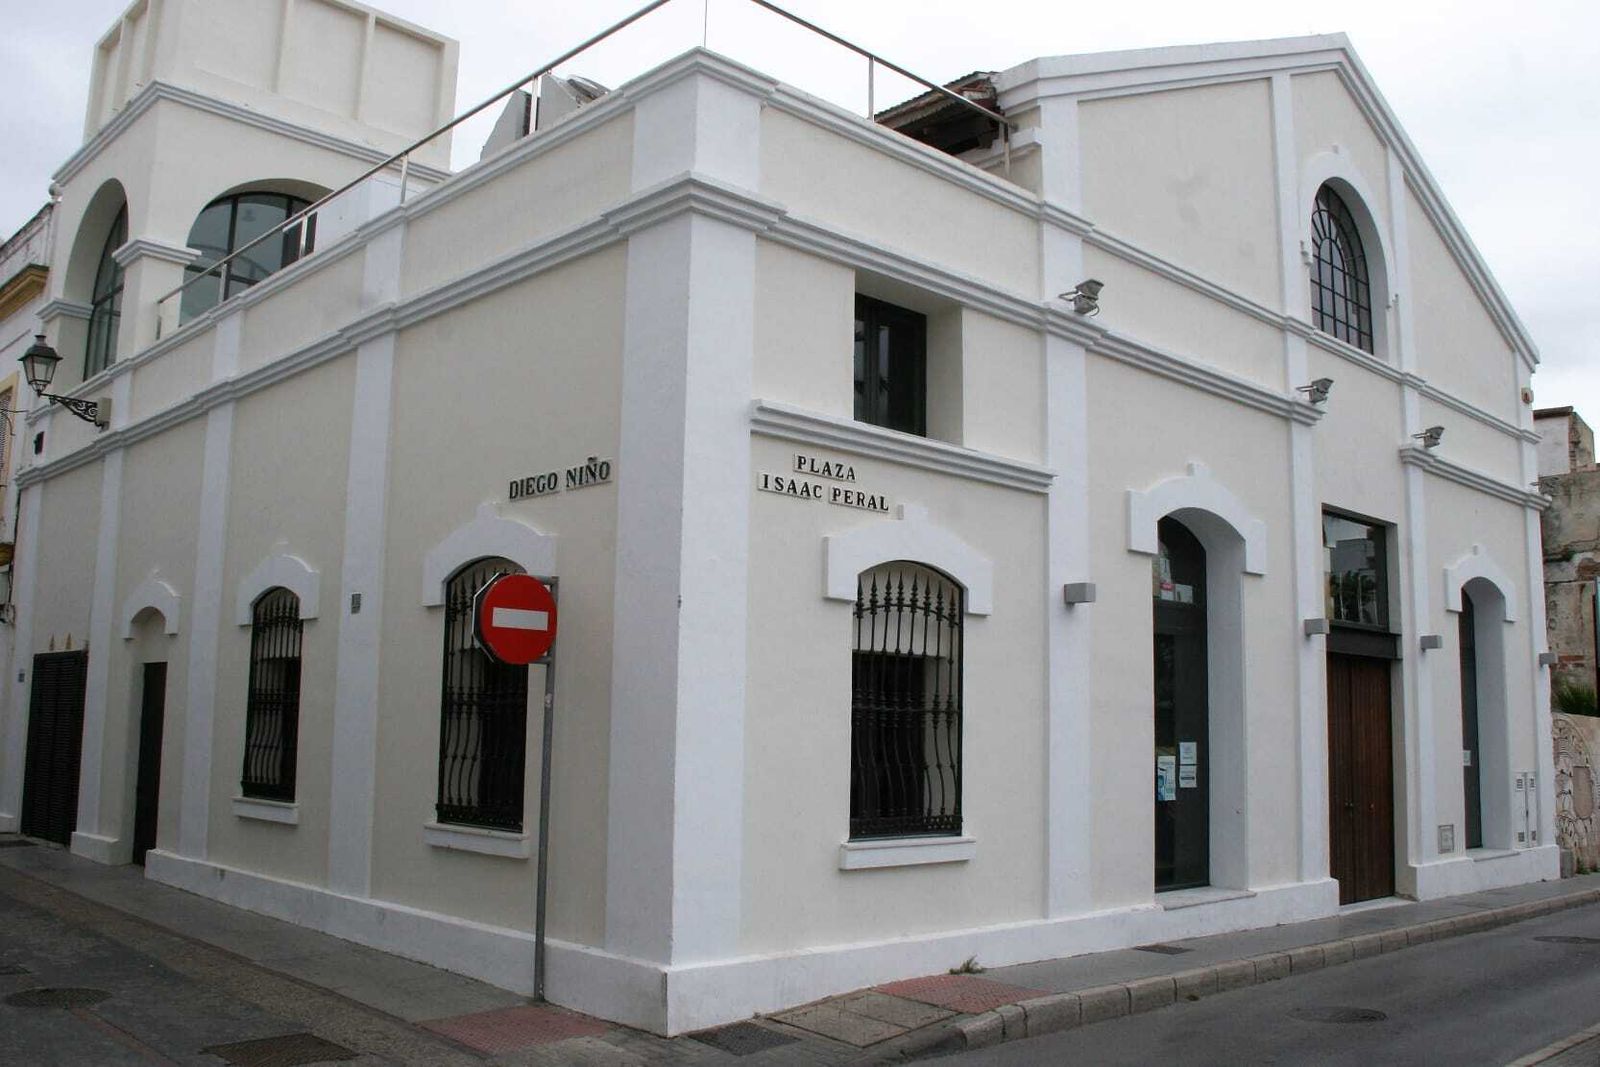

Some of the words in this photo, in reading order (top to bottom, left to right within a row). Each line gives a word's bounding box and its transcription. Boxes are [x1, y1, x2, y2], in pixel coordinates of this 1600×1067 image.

[509, 472, 558, 500] DIEGO
[566, 456, 611, 488] NIÑO
[797, 455, 856, 481] PLAZA
[762, 473, 823, 499] ISAAC
[832, 487, 890, 511] PERAL
